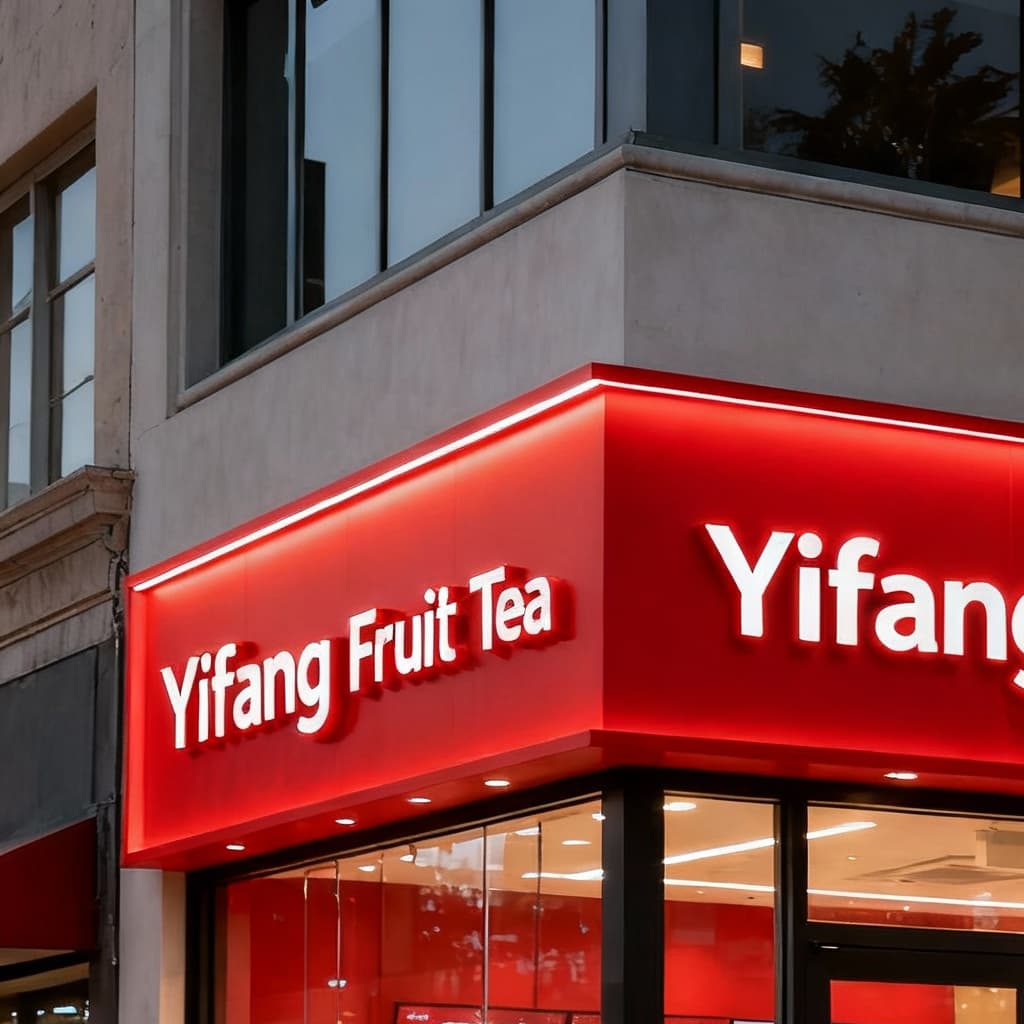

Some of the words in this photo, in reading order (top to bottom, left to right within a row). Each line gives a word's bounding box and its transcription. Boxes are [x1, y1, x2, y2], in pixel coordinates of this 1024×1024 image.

[160, 639, 332, 749] Yifang
[348, 585, 458, 693] Fruit
[468, 565, 552, 651] Tea
